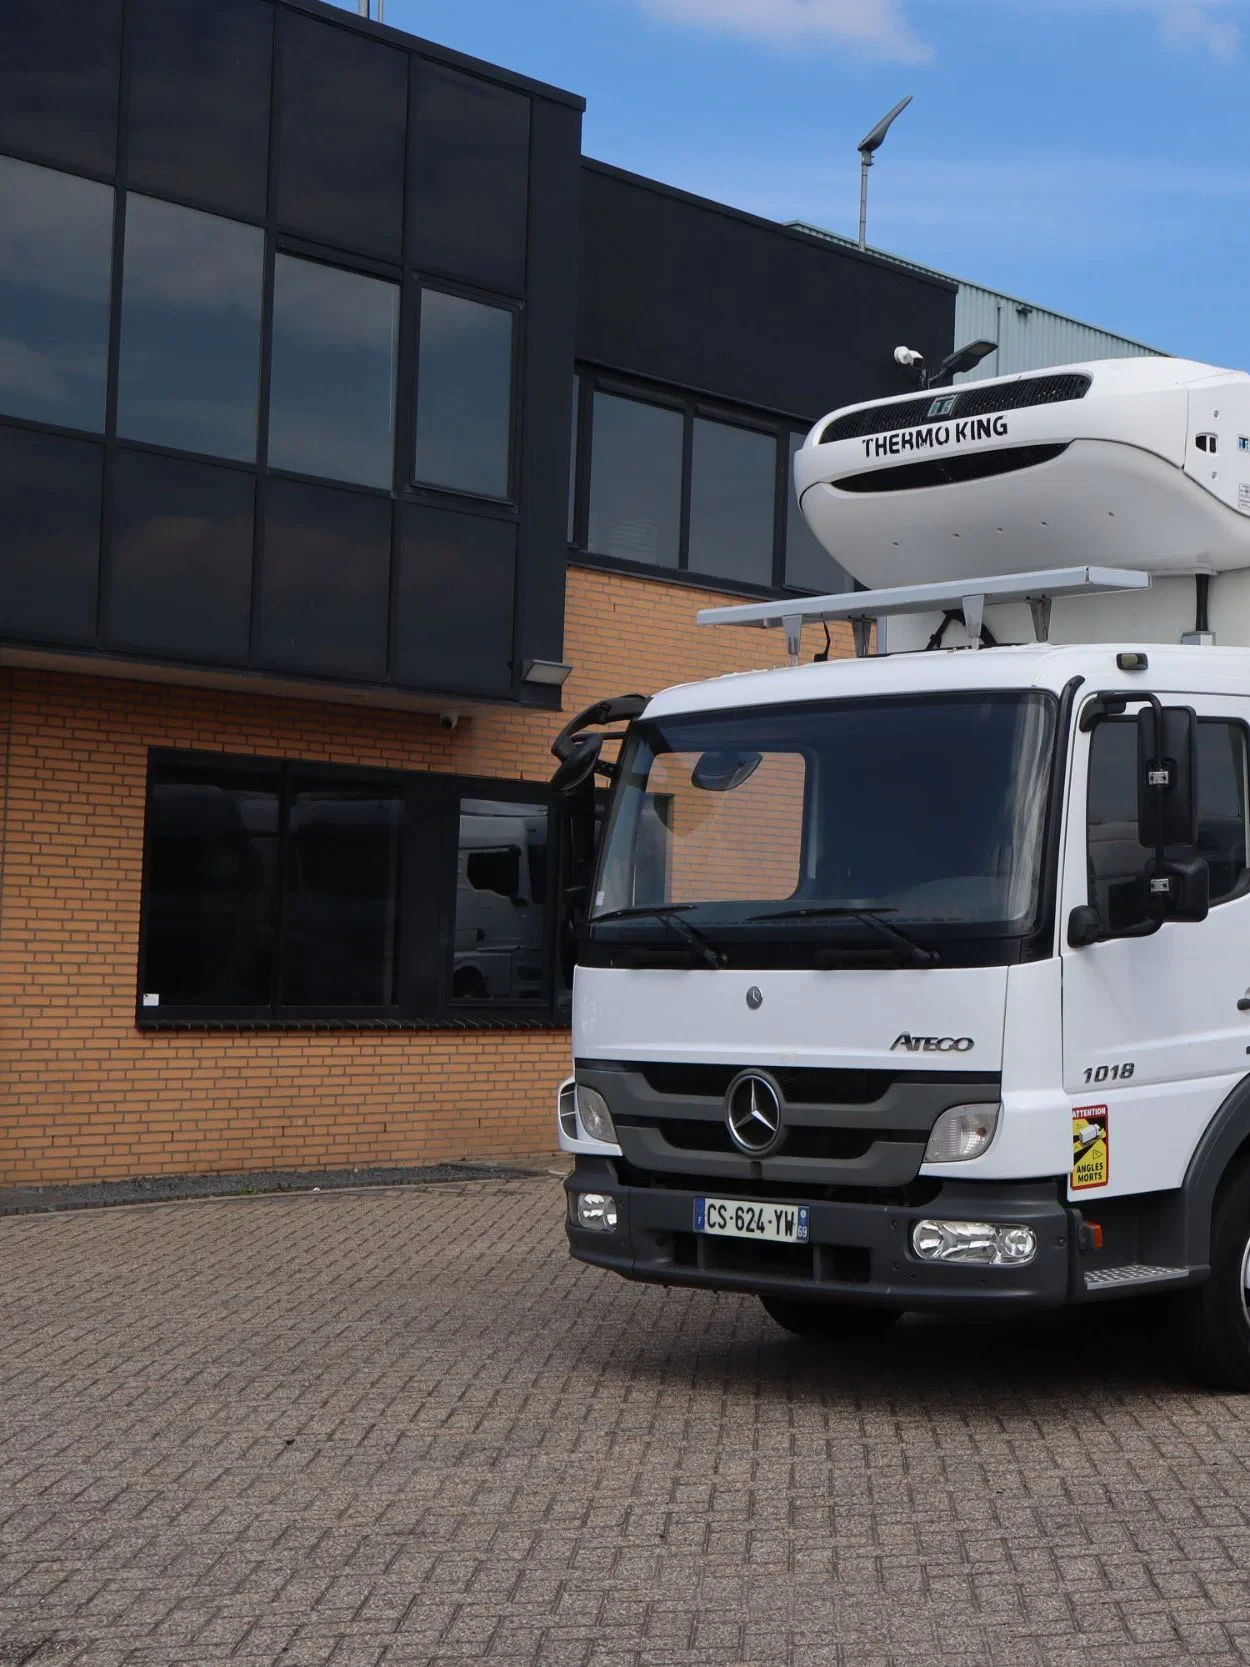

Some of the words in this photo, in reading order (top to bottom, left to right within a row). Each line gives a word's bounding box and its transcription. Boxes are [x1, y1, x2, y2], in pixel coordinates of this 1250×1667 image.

[862, 427, 950, 458] THERMO
[955, 415, 1008, 443] KING
[1083, 1062, 1135, 1085] 1018
[1072, 1106, 1106, 1119] ATTENTION
[1076, 1162, 1104, 1174] ANGLES
[1077, 1171, 1103, 1184] MORTS
[707, 1203, 795, 1238] CS-624-YW
[797, 1225, 808, 1238] 69
